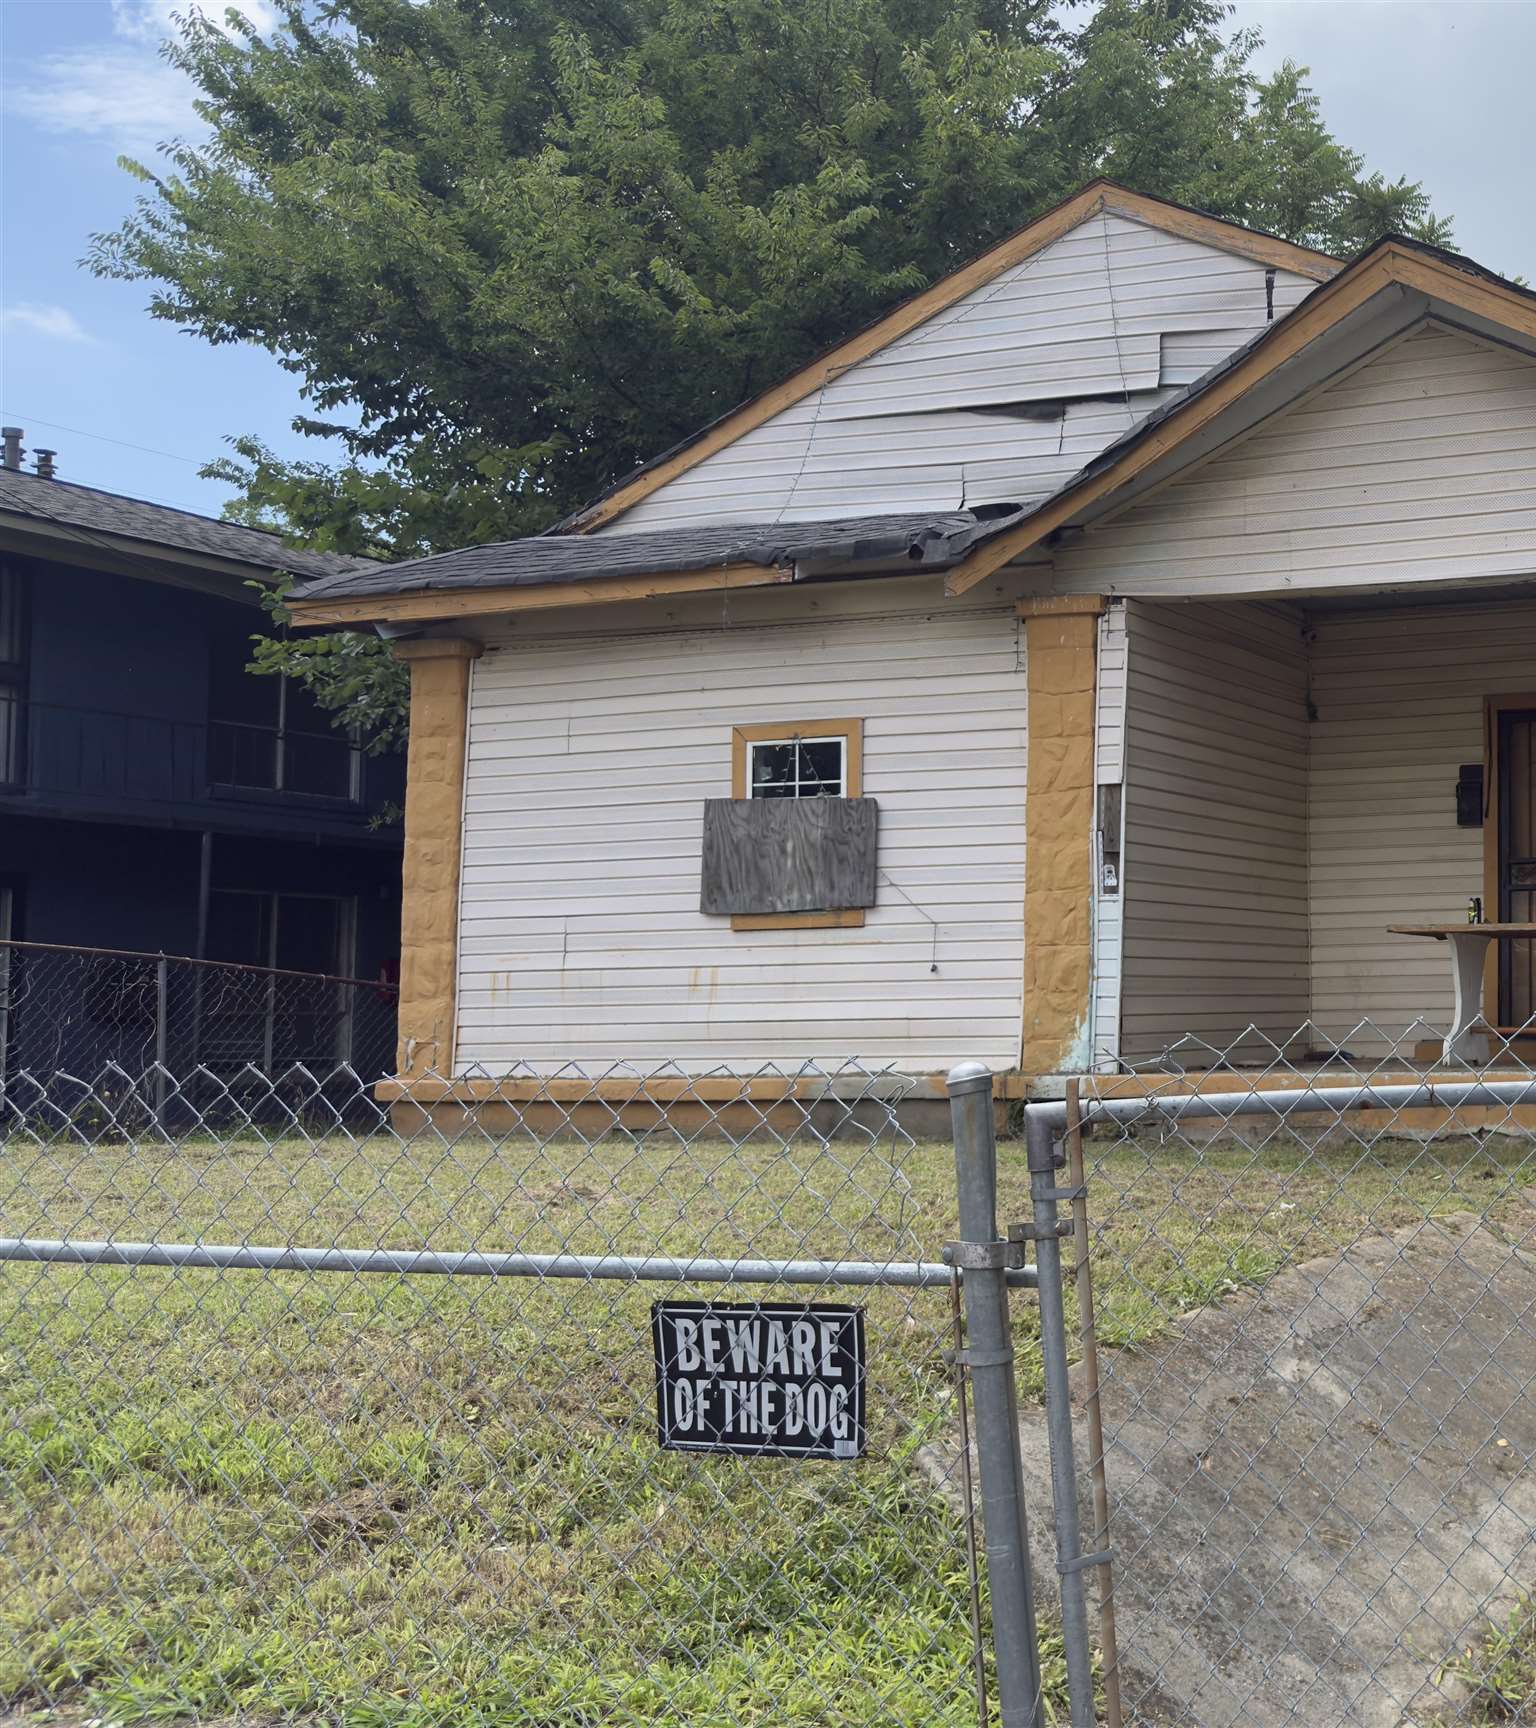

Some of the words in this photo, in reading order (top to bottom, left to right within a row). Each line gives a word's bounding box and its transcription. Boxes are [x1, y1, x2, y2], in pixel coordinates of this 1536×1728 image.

[675, 1318, 842, 1376] BEWARE
[674, 1378, 711, 1431] OF
[720, 1381, 777, 1434] THE
[785, 1383, 849, 1438] DOG
